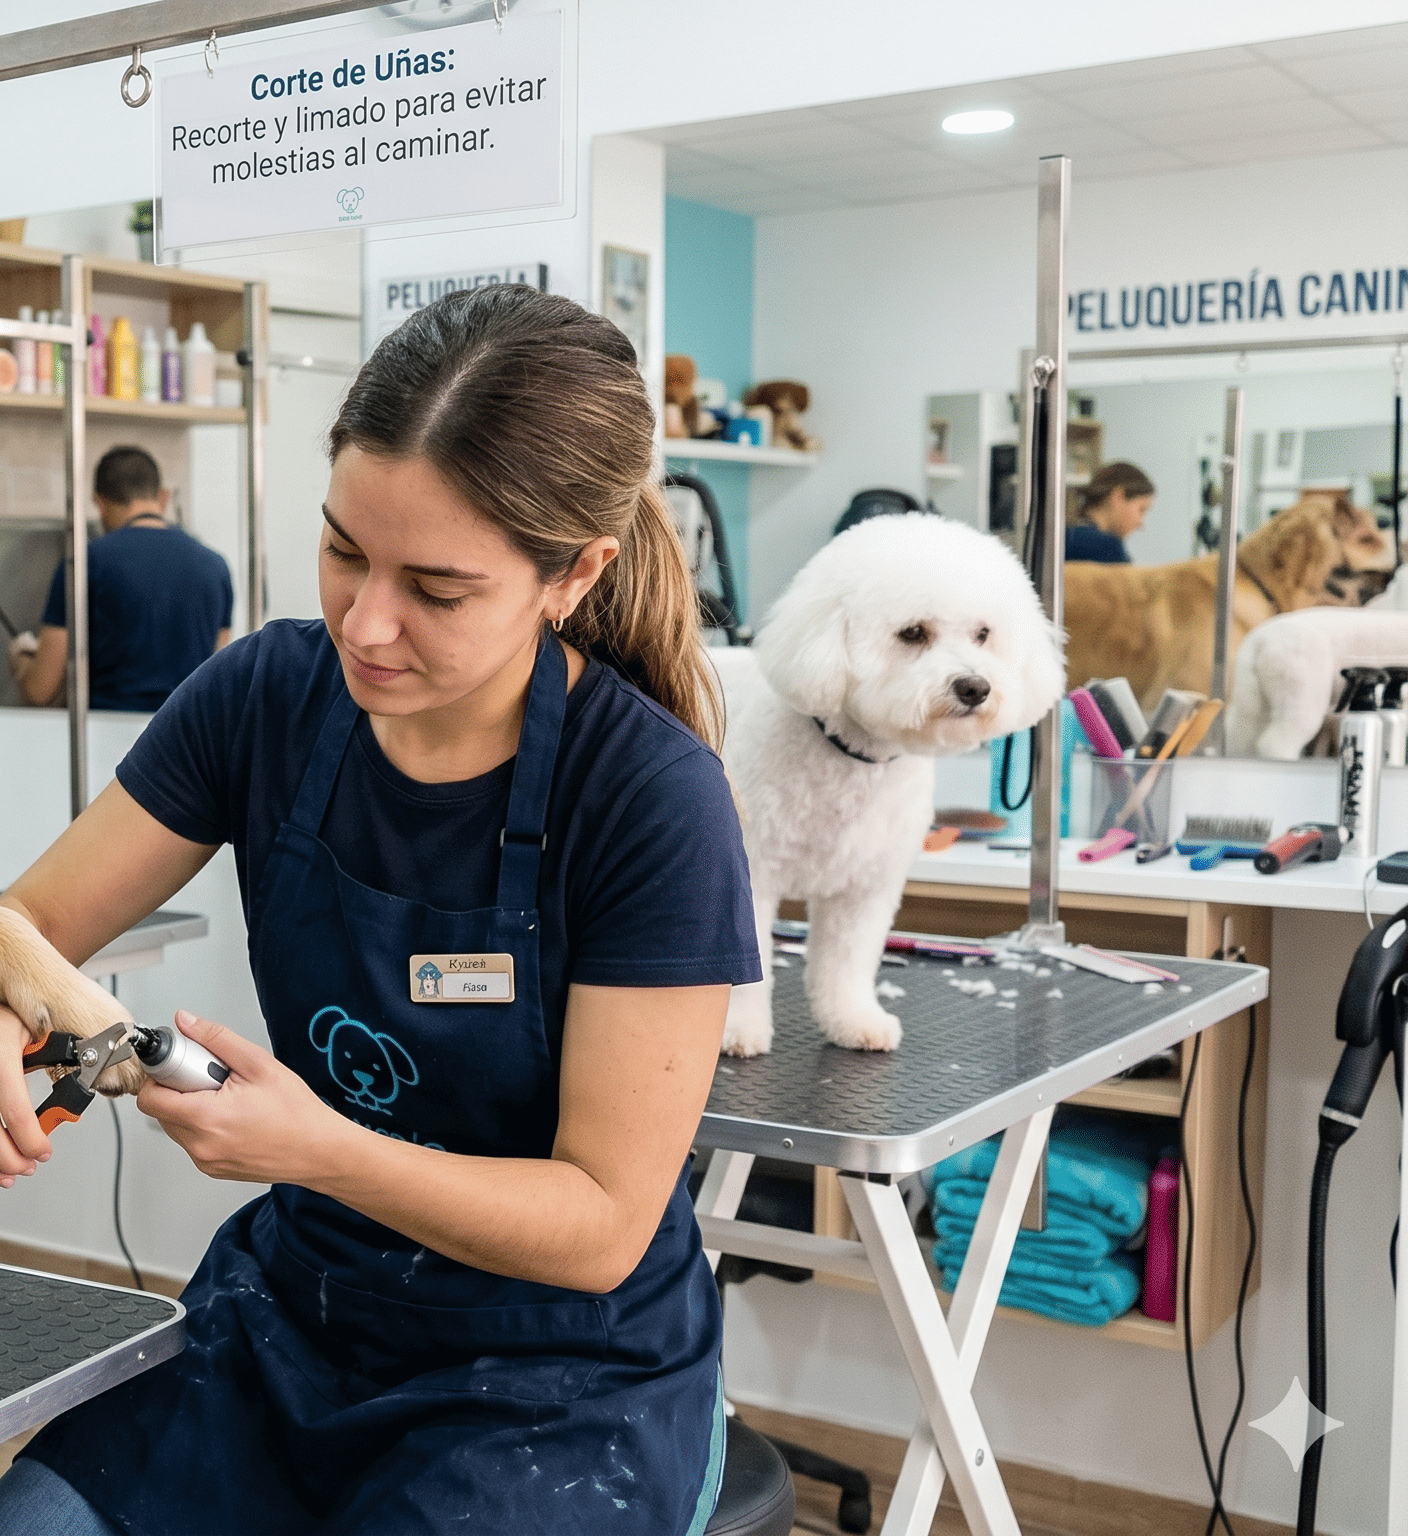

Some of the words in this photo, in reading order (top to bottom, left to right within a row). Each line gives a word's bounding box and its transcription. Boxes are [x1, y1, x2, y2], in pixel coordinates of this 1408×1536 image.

[251, 68, 324, 101] Corte
[332, 58, 366, 89] de
[375, 47, 455, 81] Uñas:
[172, 115, 267, 151] Recorte
[274, 115, 288, 144] y
[296, 96, 386, 134] limado
[395, 90, 455, 127] para
[465, 76, 547, 109] evitar
[212, 147, 335, 184] molestias
[344, 136, 366, 167] al
[375, 124, 495, 163] caminar.
[1068, 267, 1285, 332] ELUQUERÍA
